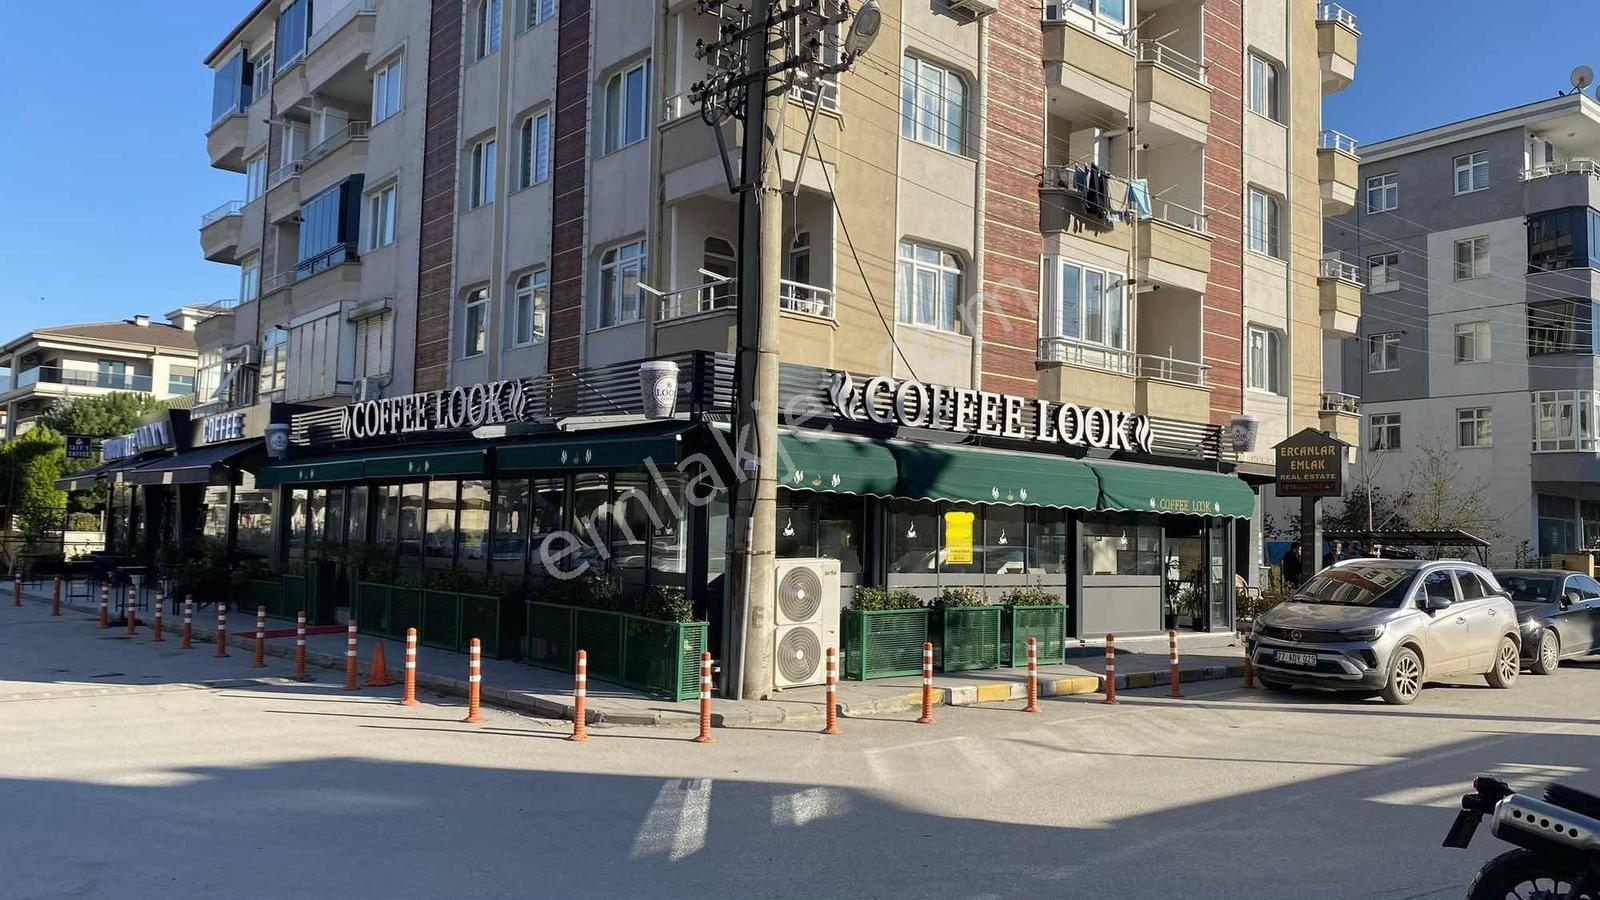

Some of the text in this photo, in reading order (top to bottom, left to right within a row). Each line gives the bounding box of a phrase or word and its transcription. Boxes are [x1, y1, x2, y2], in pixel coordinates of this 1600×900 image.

[352, 383, 504, 438] COFFEE LOOK
[866, 377, 1132, 449] COFFEE LOOK
[203, 412, 242, 443] COFFEE
[1281, 445, 1336, 456] ERCANLAR
[1290, 460, 1325, 470] EMLAK
[1160, 498, 1211, 512] COFFEE LOOK
